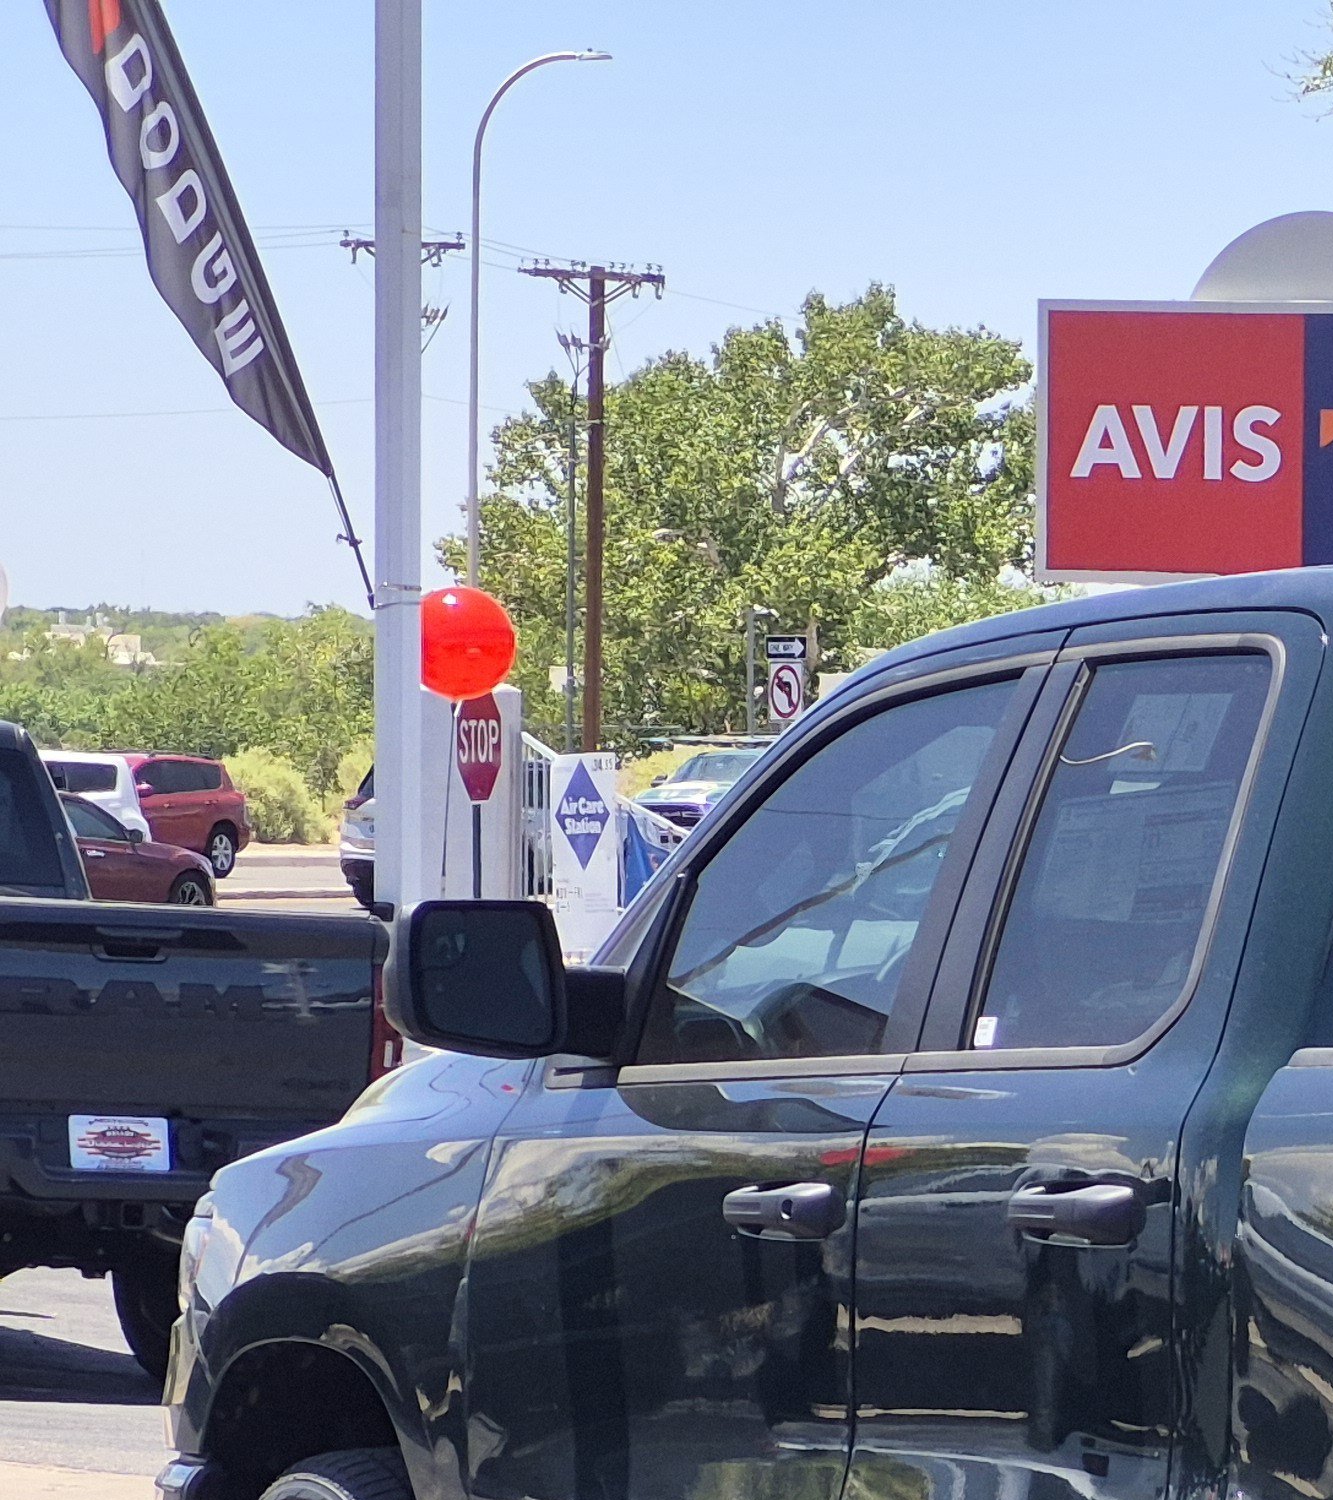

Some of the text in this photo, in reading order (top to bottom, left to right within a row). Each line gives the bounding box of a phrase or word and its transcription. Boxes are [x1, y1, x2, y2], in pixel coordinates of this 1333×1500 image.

[105, 32, 265, 377] DODGE
[1069, 404, 1282, 483] AVIS
[459, 719, 500, 764] STOP
[560, 796, 605, 815] Air Care
[564, 818, 602, 836] Station
